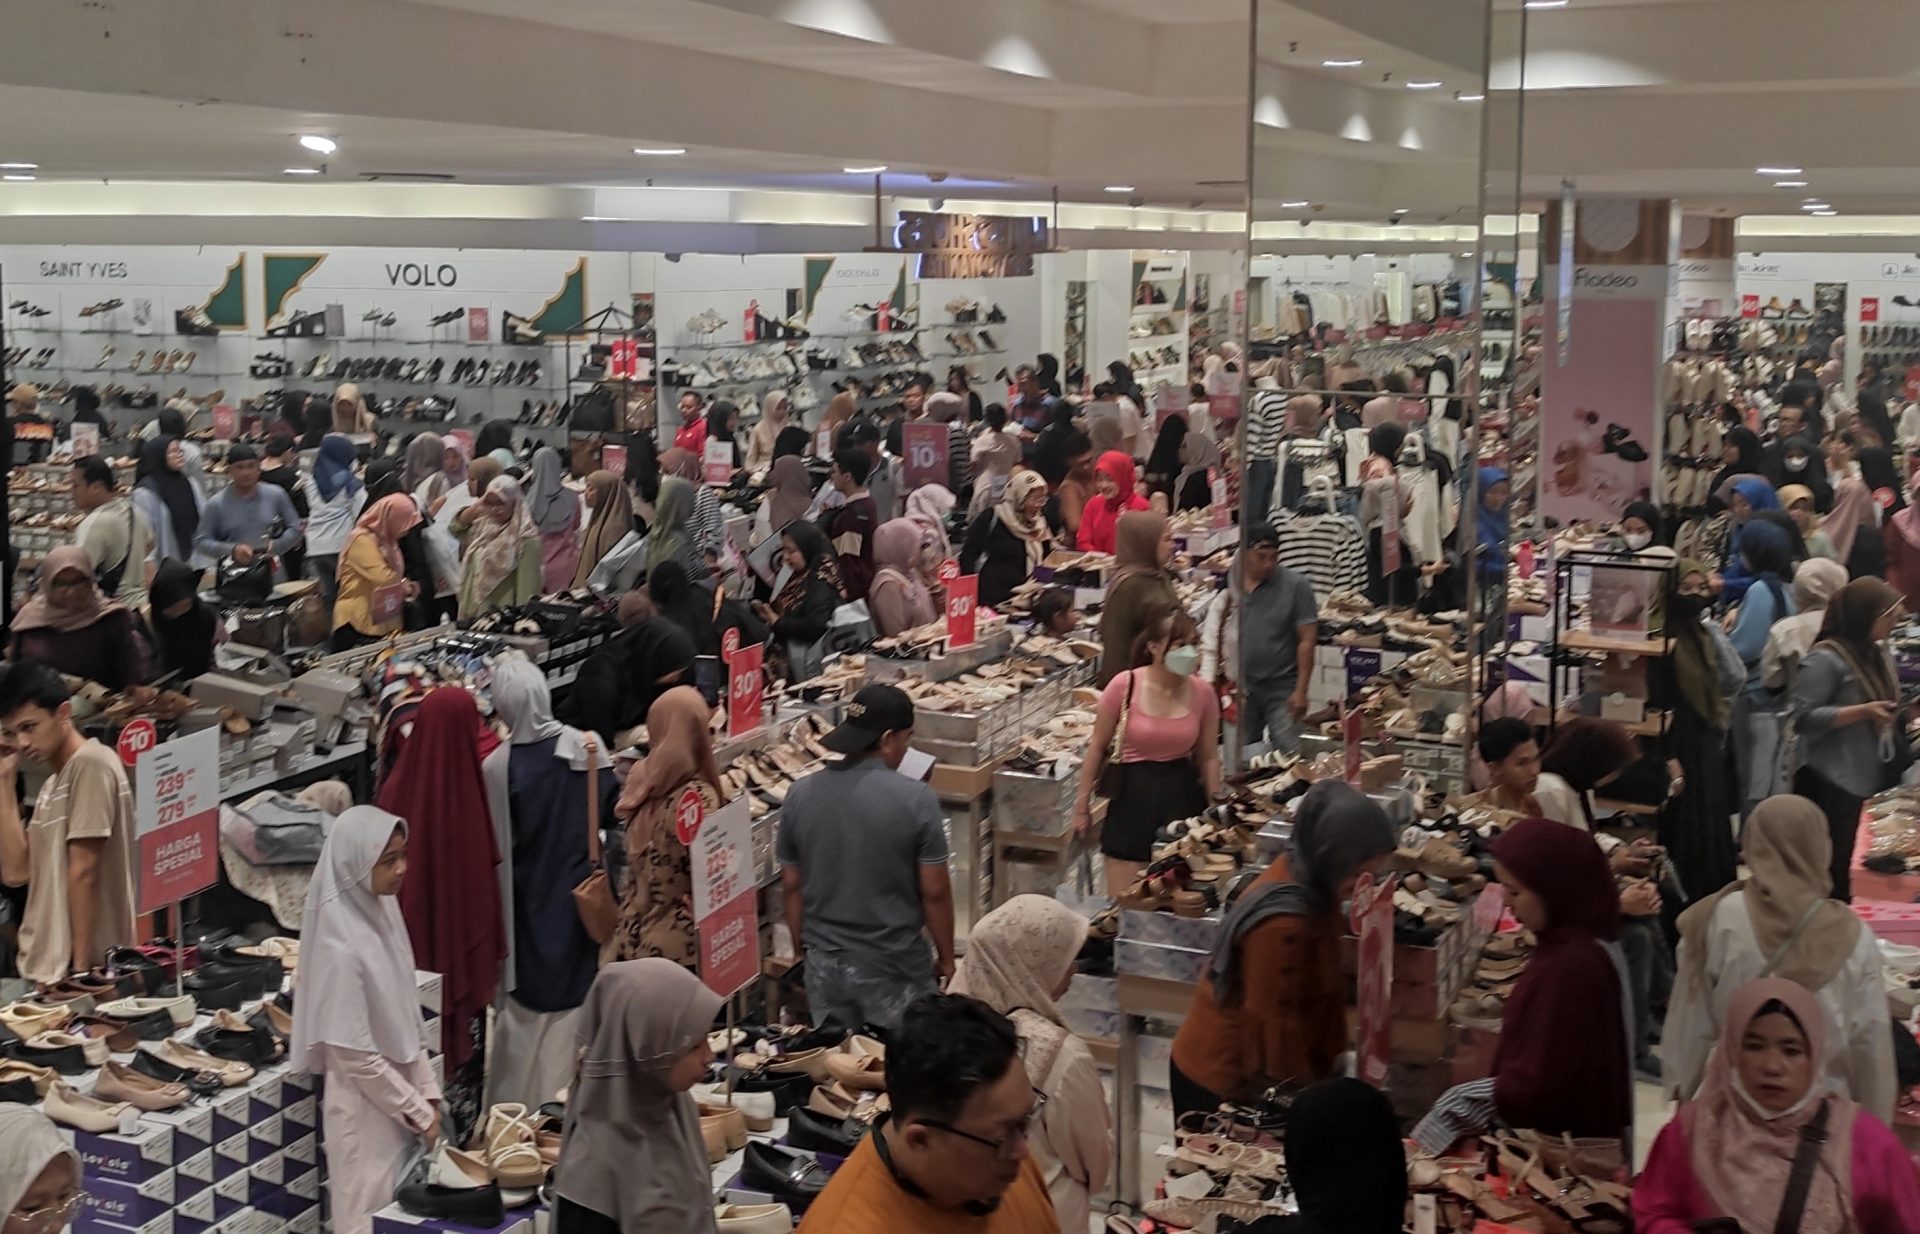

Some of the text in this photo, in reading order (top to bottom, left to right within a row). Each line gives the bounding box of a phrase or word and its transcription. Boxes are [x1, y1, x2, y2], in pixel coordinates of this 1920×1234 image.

[40, 260, 128, 279] SAINT YVES
[385, 263, 458, 288] VOLO
[156, 771, 185, 798] 239
[156, 800, 185, 826] 279
[155, 831, 201, 861] HARGA
[153, 846, 204, 877] SPESIAL
[710, 916, 745, 950] HARGA
[710, 932, 746, 969] SPESIAL
